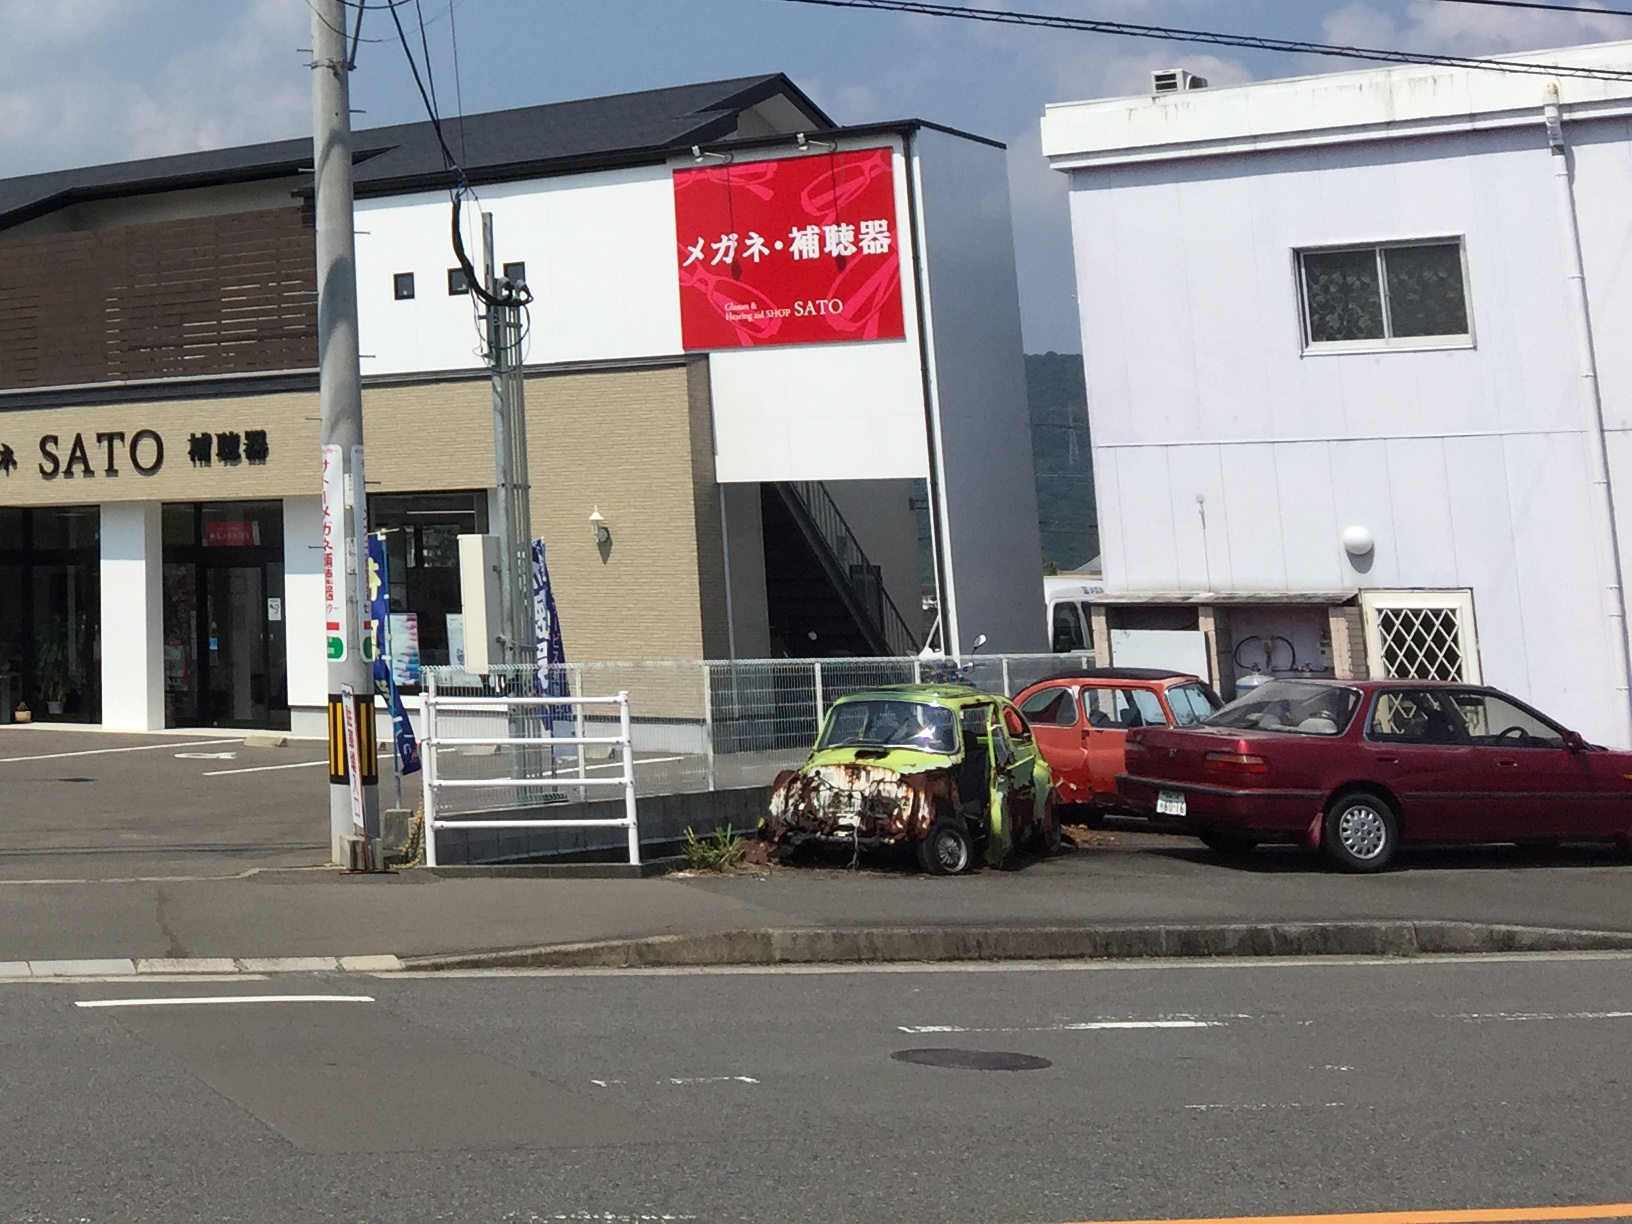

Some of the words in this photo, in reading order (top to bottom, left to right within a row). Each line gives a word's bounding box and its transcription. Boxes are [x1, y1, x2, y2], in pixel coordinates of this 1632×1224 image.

[683, 219, 892, 266] メガネ・補聴器
[765, 308, 791, 318] SHOP
[794, 298, 843, 317] SATO
[38, 429, 165, 481] SATO
